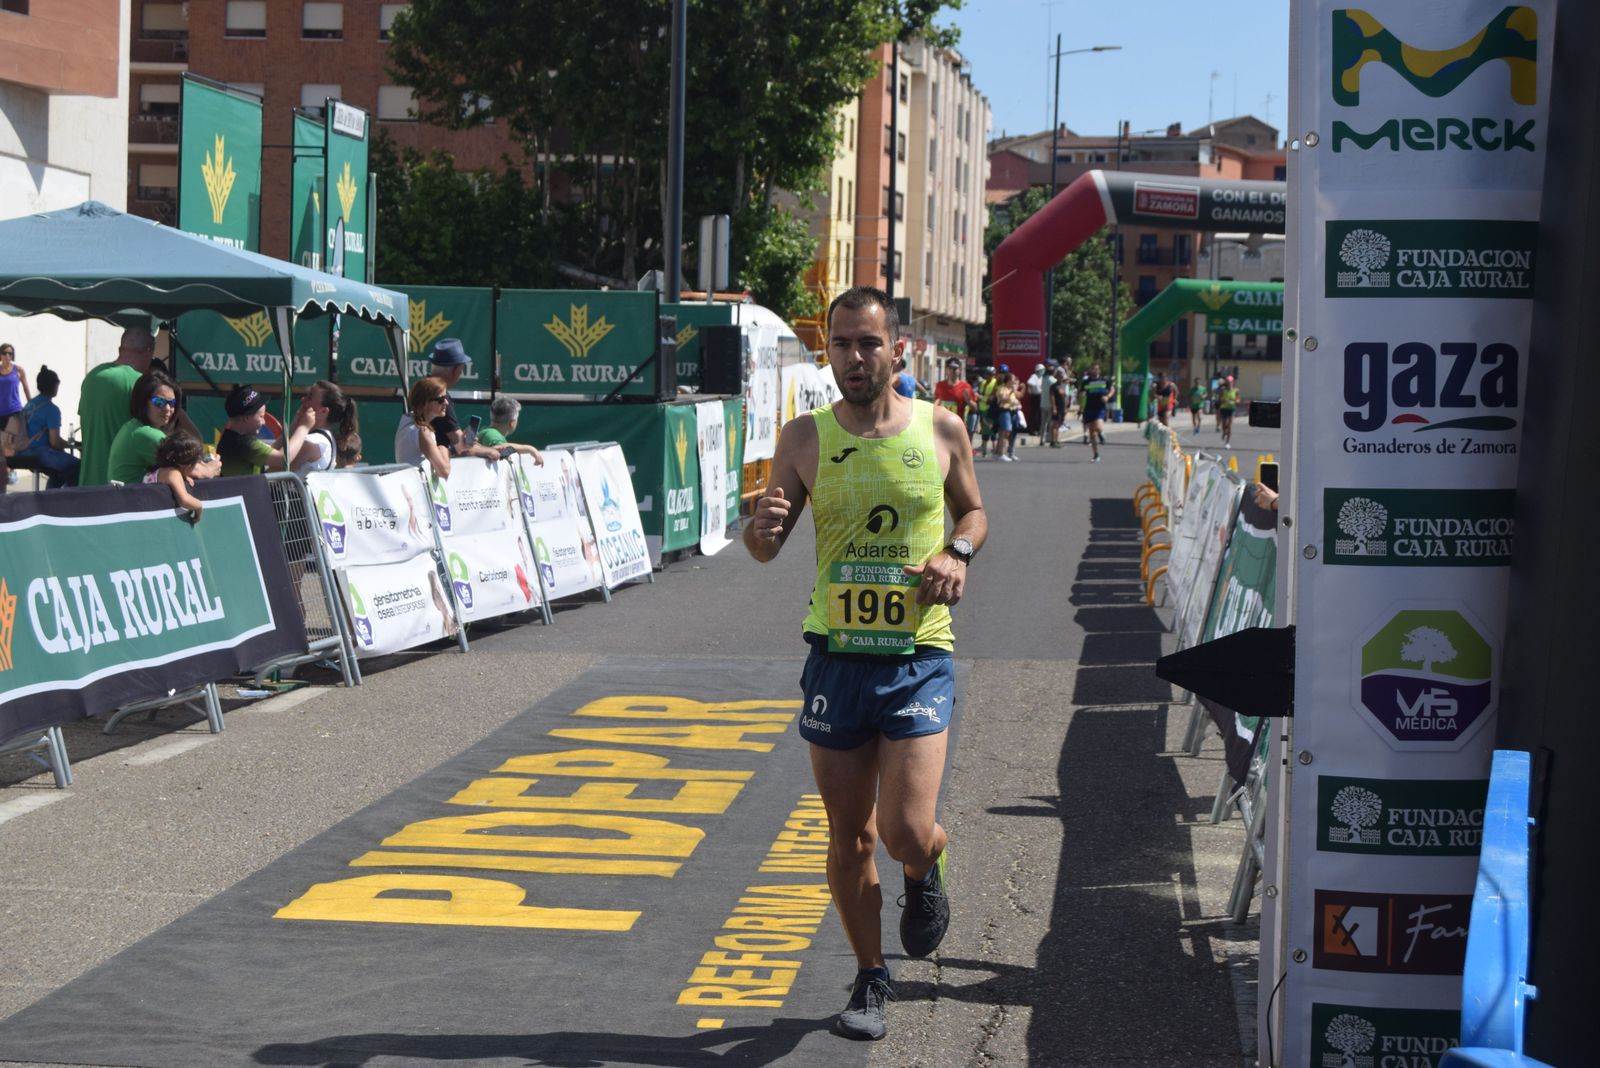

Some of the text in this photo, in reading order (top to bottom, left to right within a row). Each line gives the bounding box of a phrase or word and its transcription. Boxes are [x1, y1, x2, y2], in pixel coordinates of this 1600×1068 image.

[1150, 200, 1195, 213] ZAMORA
[1212, 189, 1245, 203] CON
[1249, 191, 1266, 205] EL
[1211, 207, 1285, 223] GANAMOS
[1396, 249, 1532, 269] FUNDACION
[1396, 270, 1529, 289] CAJA RURAL
[1233, 290, 1275, 306] CAJA
[191, 351, 239, 371] CAJA
[350, 356, 399, 376] CAJA
[514, 363, 644, 384] CAJA RURAL
[1342, 342, 1519, 432] gaza
[1342, 437, 1517, 454] Ganaderos de Zamora
[845, 542, 910, 559] Adarsa
[1393, 538, 1449, 558] CAJA
[855, 565, 905, 576] FUNDACIO
[855, 574, 909, 585] CAJA RURAL
[27, 557, 226, 655] CAJA RURAL
[837, 588, 906, 626] 196
[852, 636, 875, 647] CAJA
[801, 714, 832, 734] Adarsa
[1387, 828, 1442, 848] CAJA
[676, 883, 833, 1008] REFORMA
